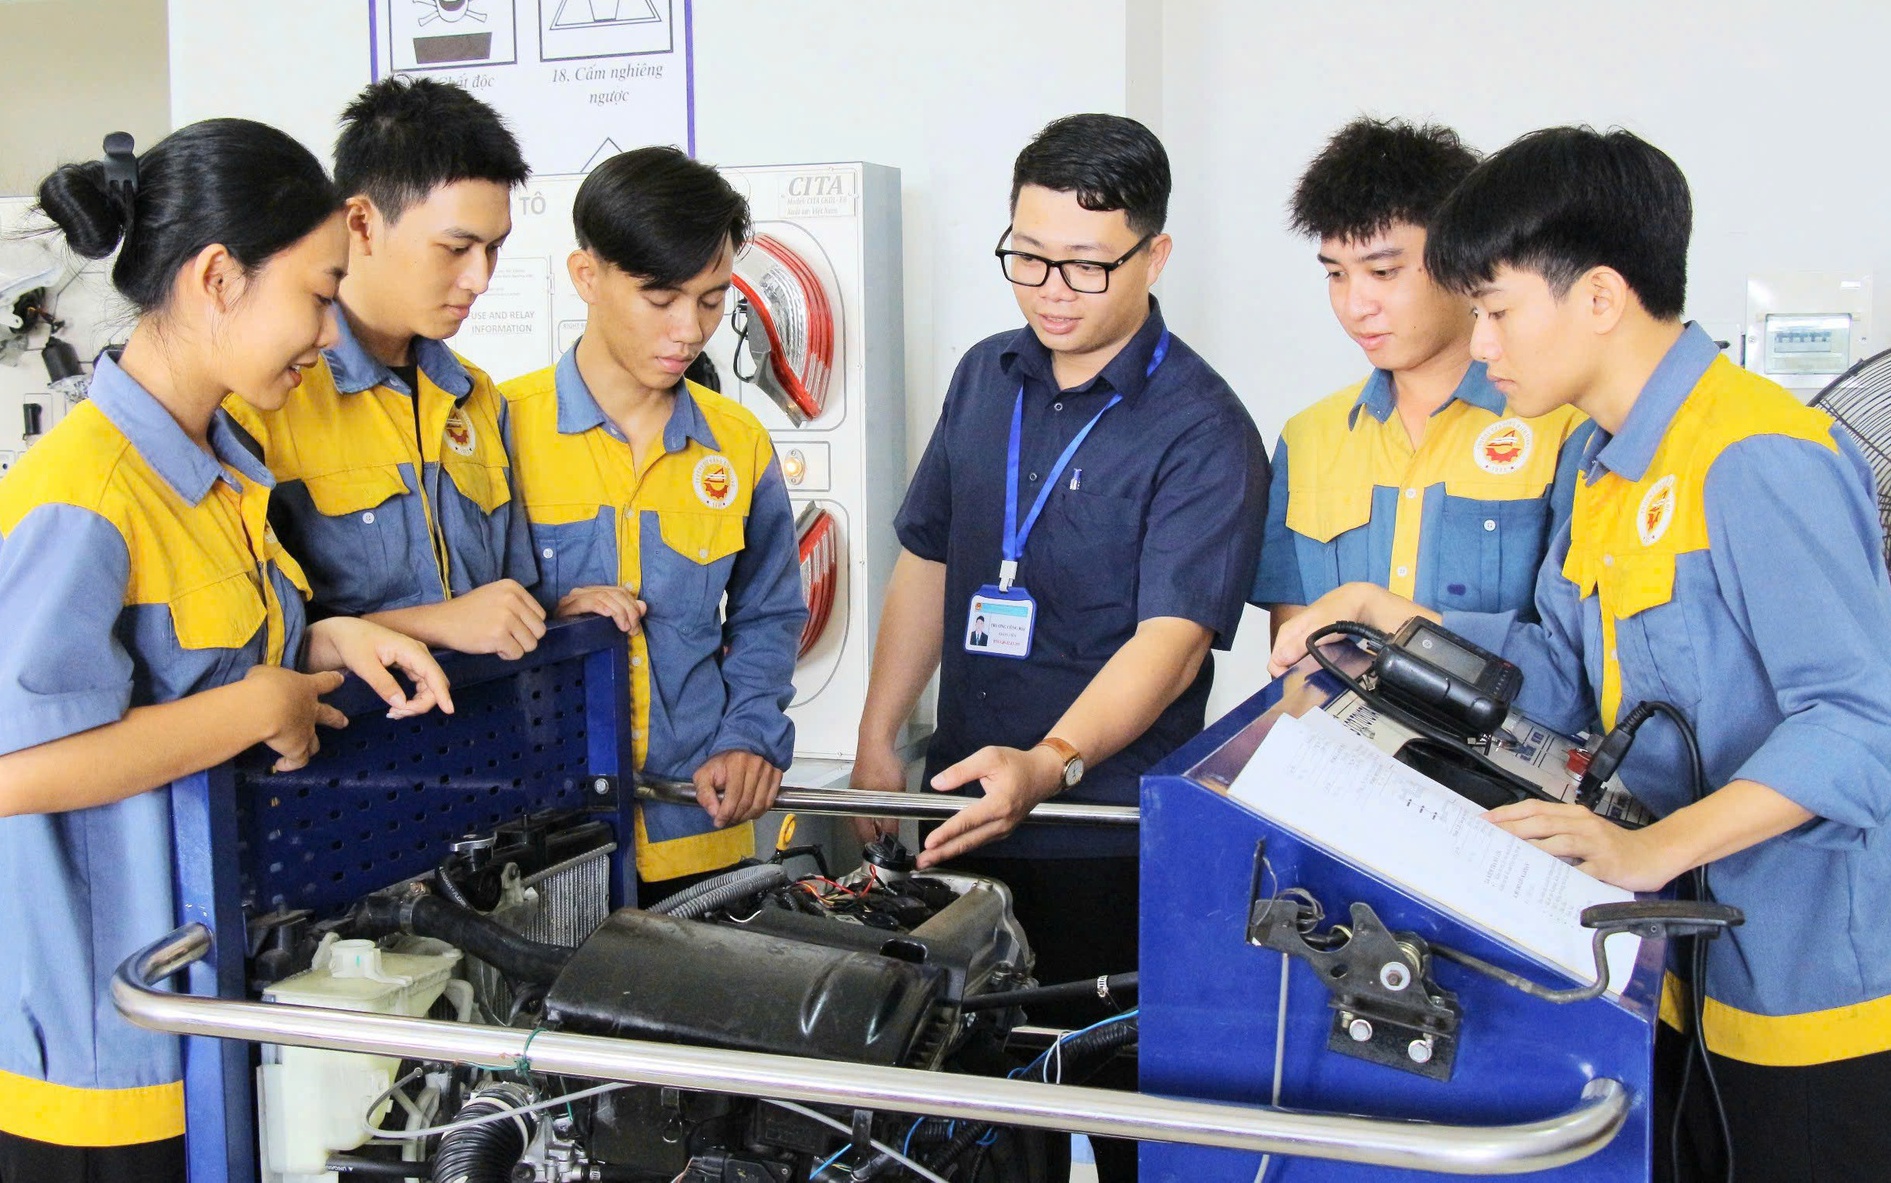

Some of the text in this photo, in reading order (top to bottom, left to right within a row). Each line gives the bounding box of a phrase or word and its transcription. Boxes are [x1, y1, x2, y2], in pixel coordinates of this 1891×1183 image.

[552, 63, 663, 83] 18. Cấm nghiêng
[589, 90, 630, 107] ngược
[788, 175, 843, 196] CITA
[519, 191, 546, 216] TÔ
[470, 311, 487, 320] USE
[509, 310, 535, 319] RELAY
[471, 324, 533, 334] INFORMATION
